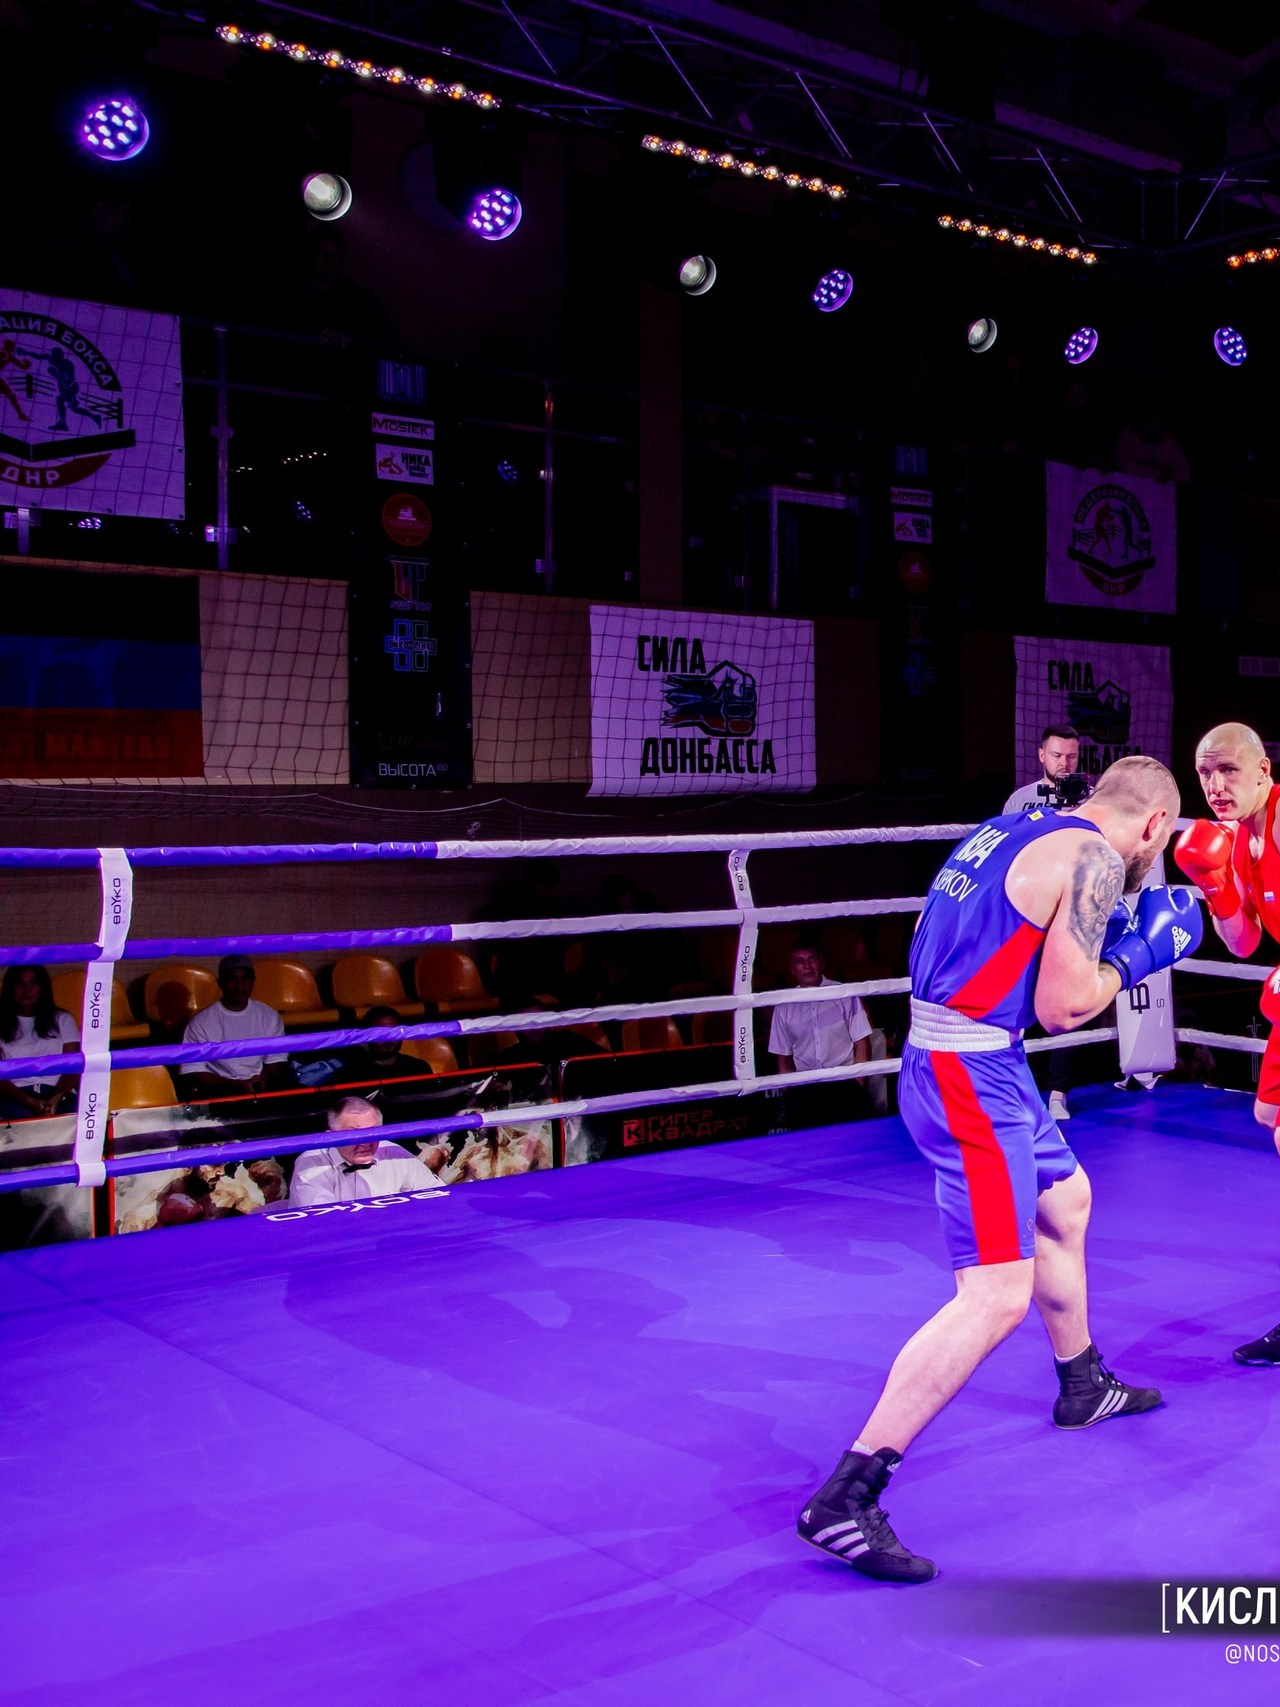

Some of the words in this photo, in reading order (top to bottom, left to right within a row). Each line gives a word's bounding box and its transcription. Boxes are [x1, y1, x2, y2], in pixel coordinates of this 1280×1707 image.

[61, 334, 113, 386] БОКСА
[1, 465, 60, 486] ДНР
[637, 634, 707, 674] СИЛА
[1047, 660, 1095, 691] СИЛА
[639, 736, 777, 777] ДОНБАССА
[734, 855, 745, 892] BOYKO
[111, 877, 122, 925] BOYKO
[741, 944, 751, 982] BOYKO
[91, 981, 103, 1030] BOYKO
[85, 1092, 98, 1141] BOYKO
[649, 1116, 751, 1143] КВАДРАТ
[650, 1108, 713, 1129] ГИПЕР
[266, 1190, 452, 1222] BOYKO
